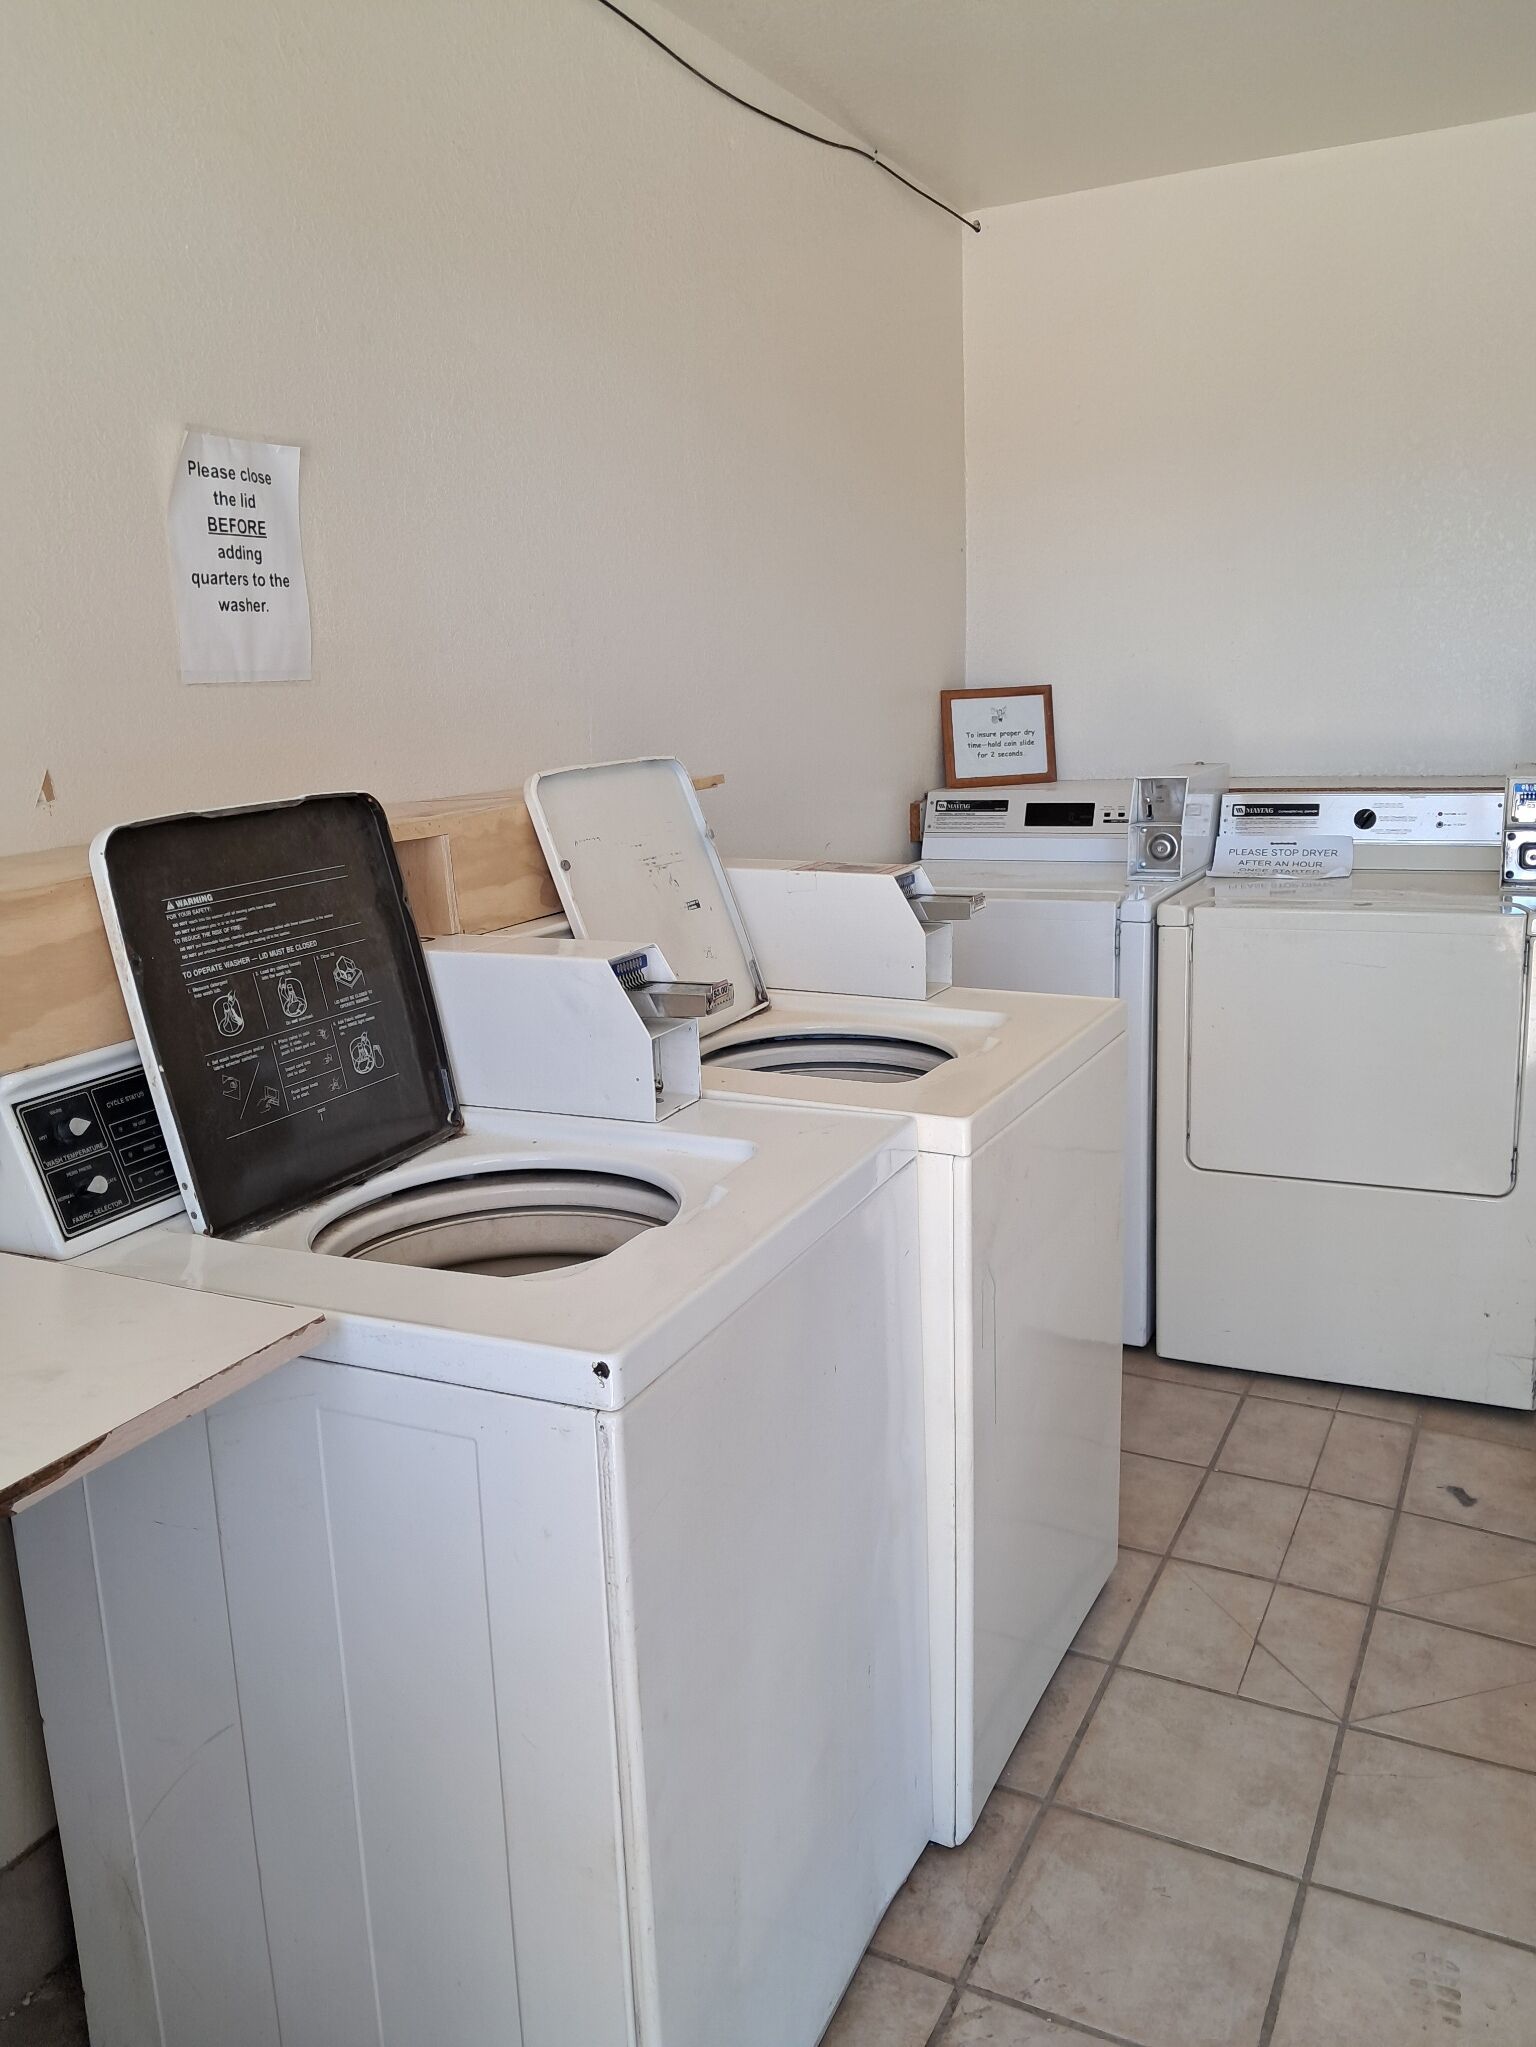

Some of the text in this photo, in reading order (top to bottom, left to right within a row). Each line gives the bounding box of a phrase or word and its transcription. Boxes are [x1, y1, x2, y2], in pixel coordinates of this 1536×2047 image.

[187, 460, 272, 485] Please close
[213, 490, 256, 508] the lid
[207, 516, 267, 537] BEFORE
[218, 544, 262, 564] adding
[191, 571, 290, 588] quarters to the
[218, 597, 270, 612] washer.
[999, 730, 1021, 738] proper
[1228, 848, 1338, 857] PLEASE STOP DRYER
[1292, 860, 1323, 868] HOUR
[175, 894, 213, 908] WARNING
[181, 934, 201, 943] REDUCE
[211, 928, 223, 936] RISK
[182, 971, 192, 979] TO
[193, 963, 223, 976] OPERATE
[223, 956, 251, 969] WASHER
[258, 952, 269, 960] LID
[269, 947, 285, 957] MUST
[286, 945, 295, 953] BE
[294, 940, 318, 951] CLOSED
[106, 1091, 145, 1109] CYCLE STATUS
[45, 1142, 105, 1168] WASH TEMPERATURE
[72, 1200, 123, 1224] FABRIC SELECTOR
